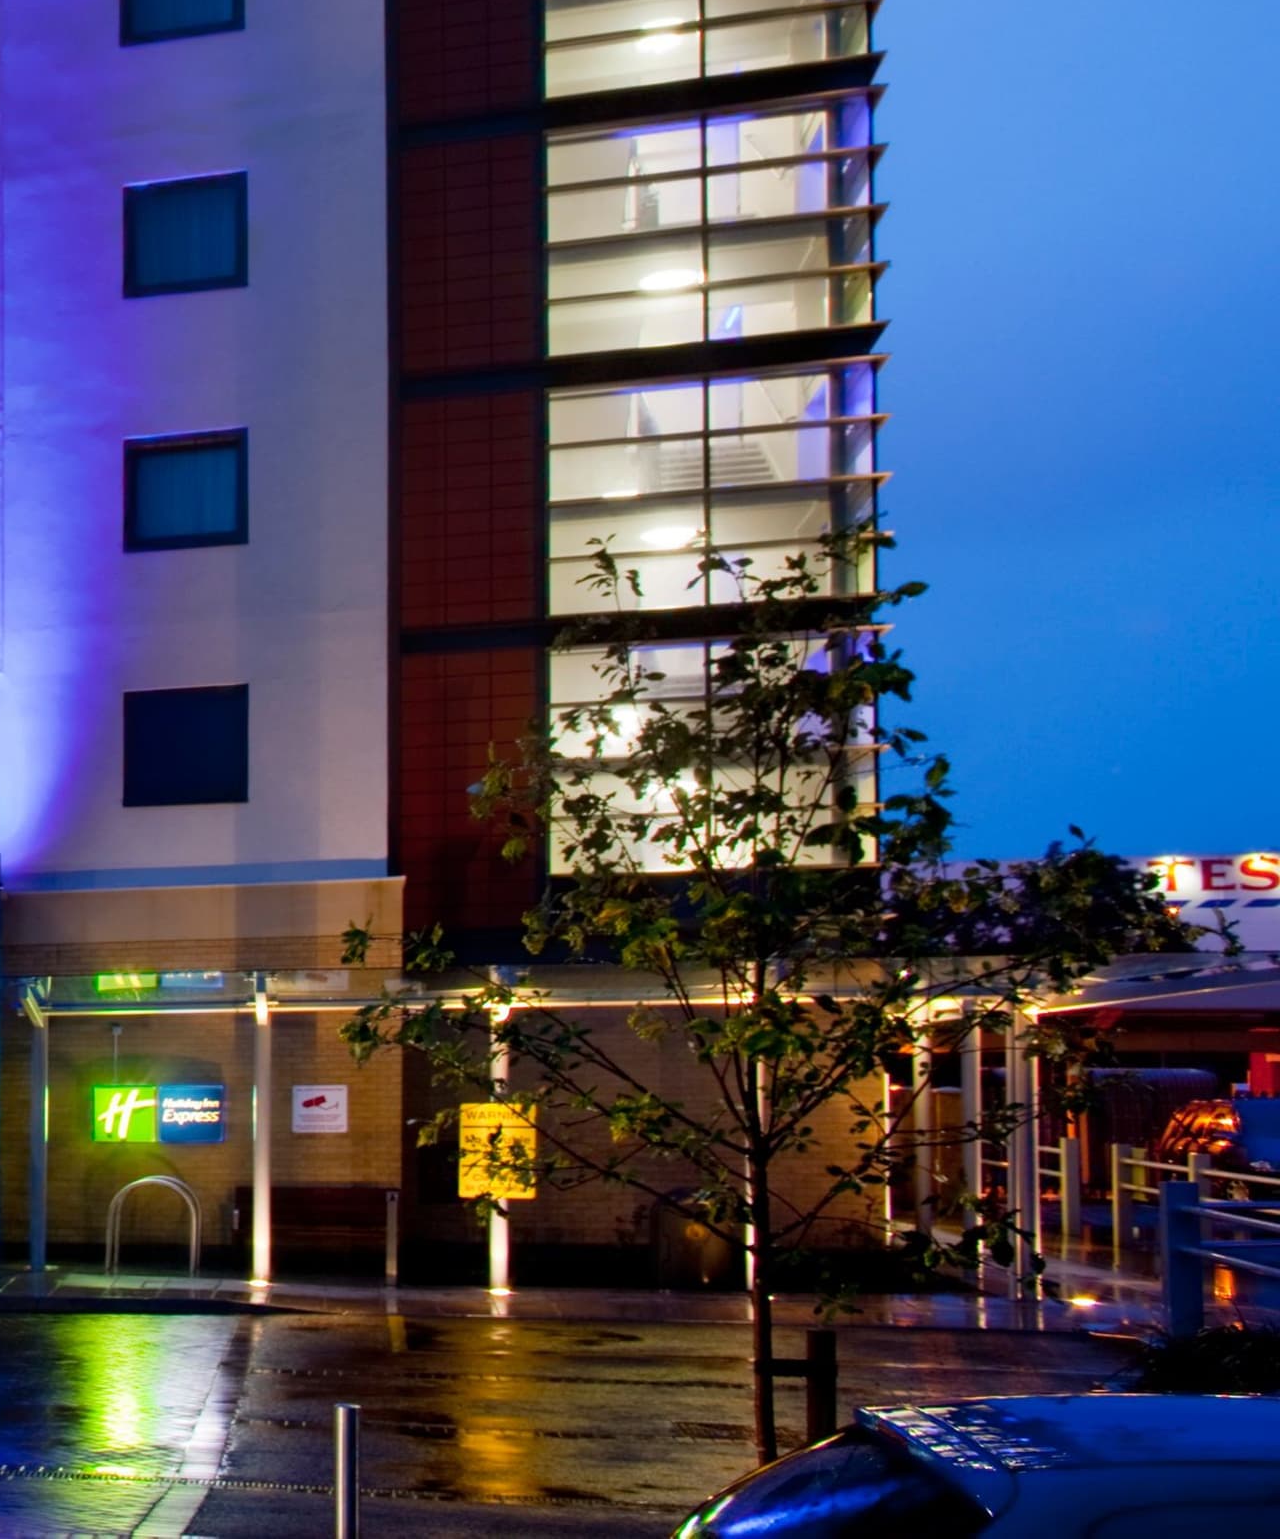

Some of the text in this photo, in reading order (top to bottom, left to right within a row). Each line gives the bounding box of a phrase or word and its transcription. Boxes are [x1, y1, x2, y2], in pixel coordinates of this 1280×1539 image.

[161, 1097, 220, 1110] Holiday Inn
[162, 1109, 220, 1125] Express
[466, 1109, 528, 1120] WARNI
